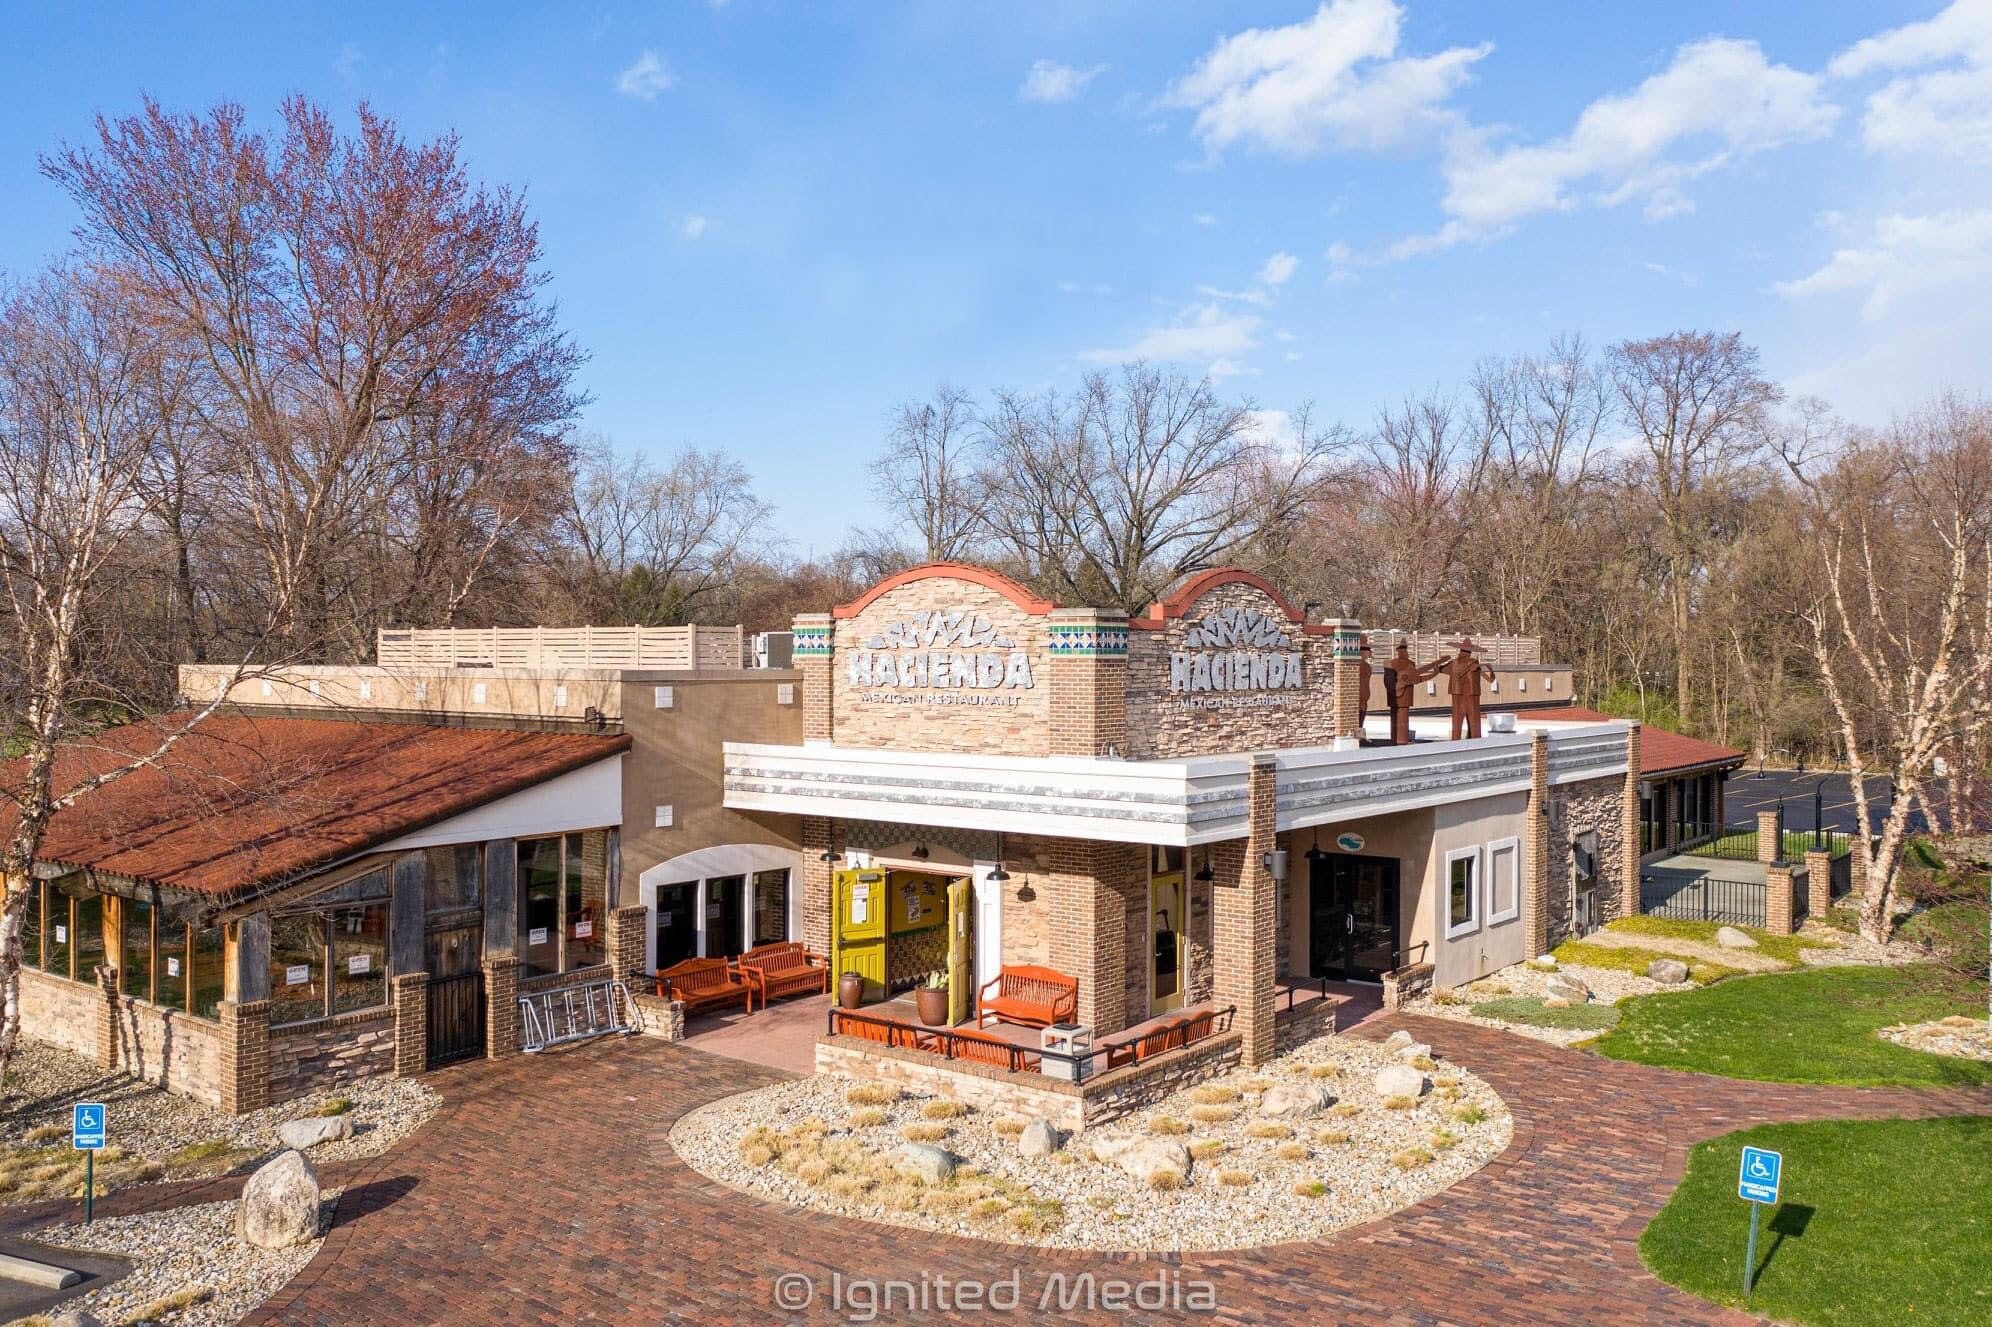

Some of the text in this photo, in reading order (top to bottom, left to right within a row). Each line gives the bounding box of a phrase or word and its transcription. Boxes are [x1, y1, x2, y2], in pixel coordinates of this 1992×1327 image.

[850, 652, 1034, 689] HACIENDA
[1170, 652, 1302, 692] HACIENDA
[862, 693, 1021, 708] MEXICAN RESTAURANT
[1180, 696, 1229, 710] MEXICAN
